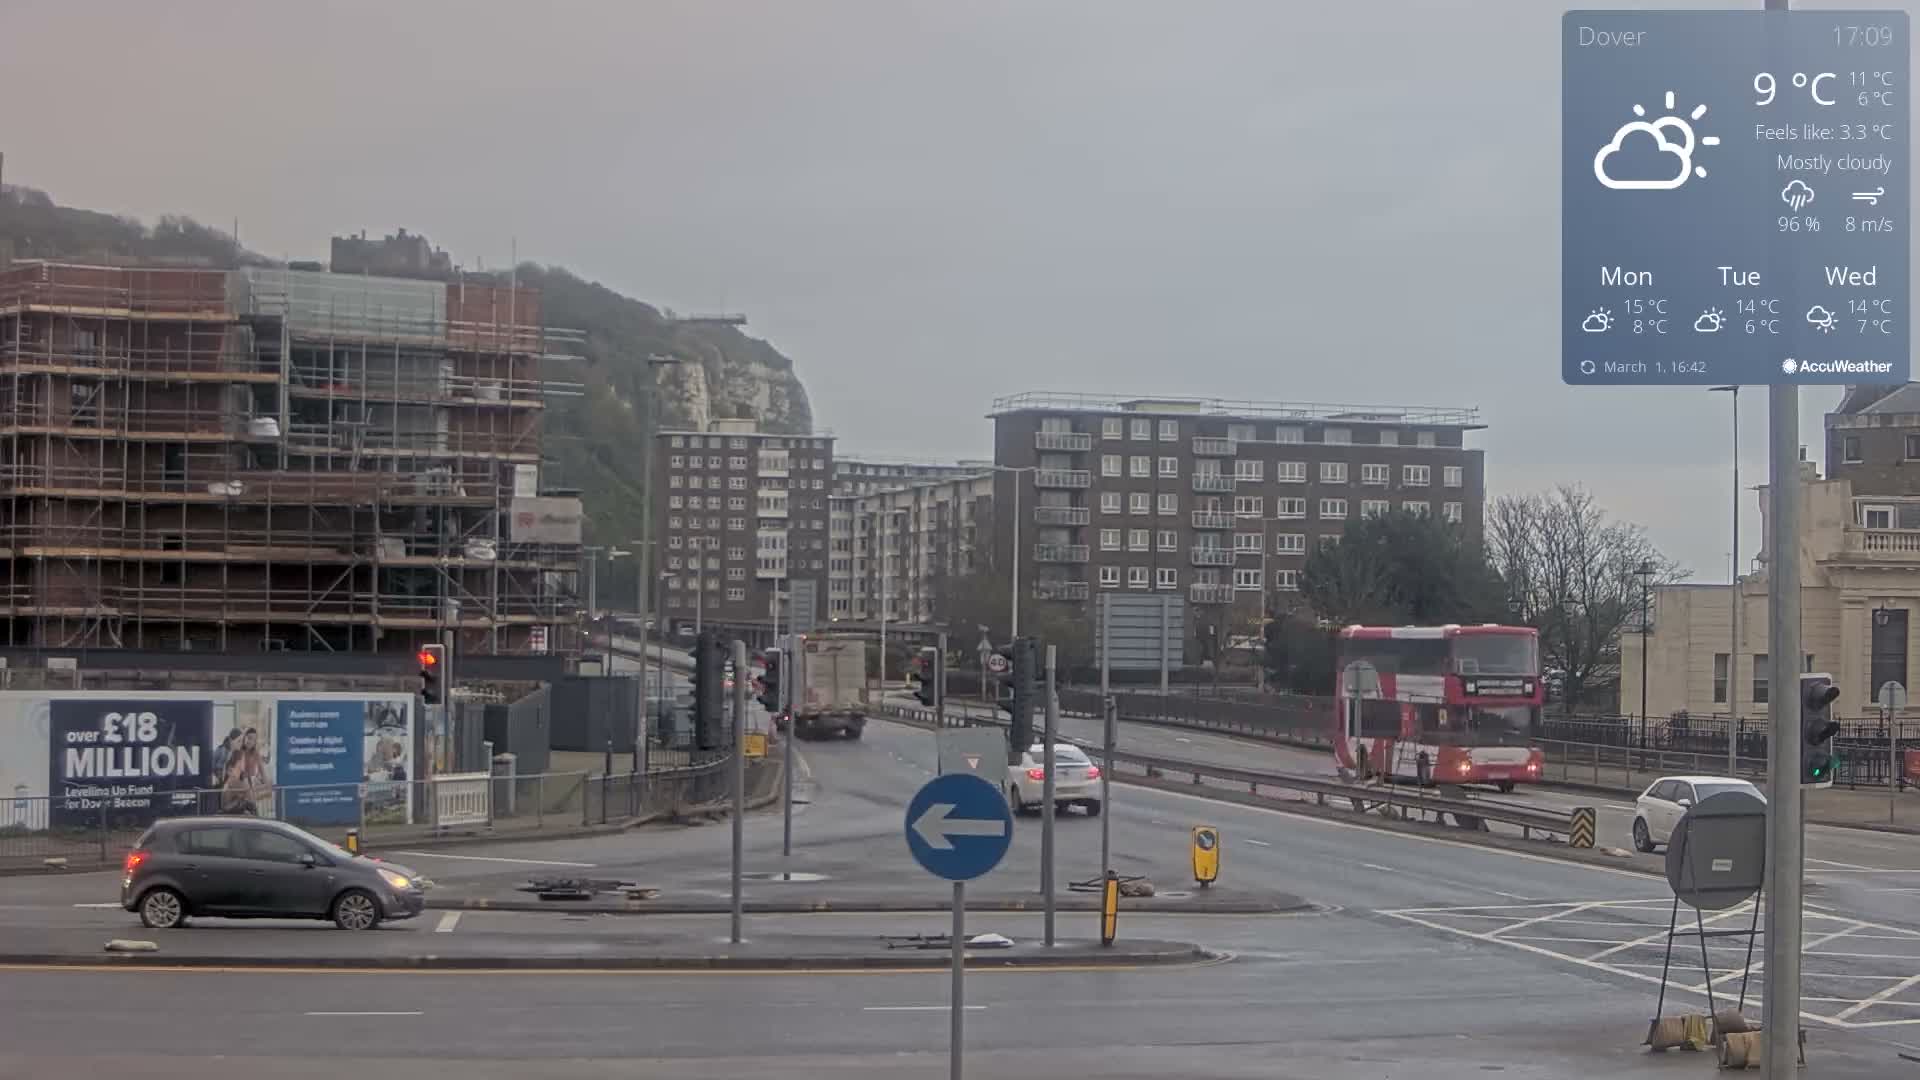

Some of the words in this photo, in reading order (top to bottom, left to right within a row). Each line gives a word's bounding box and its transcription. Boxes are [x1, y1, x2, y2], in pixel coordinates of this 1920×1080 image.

[991, 658, 1005, 667] 40
[66, 731, 99, 743] over
[104, 712, 158, 743] £18
[65, 745, 200, 778] MILLION
[65, 785, 109, 797] Levelling
[111, 785, 126, 797] Up
[128, 784, 153, 795] Fund
[65, 798, 78, 810] for
[113, 797, 150, 809] Beacon
